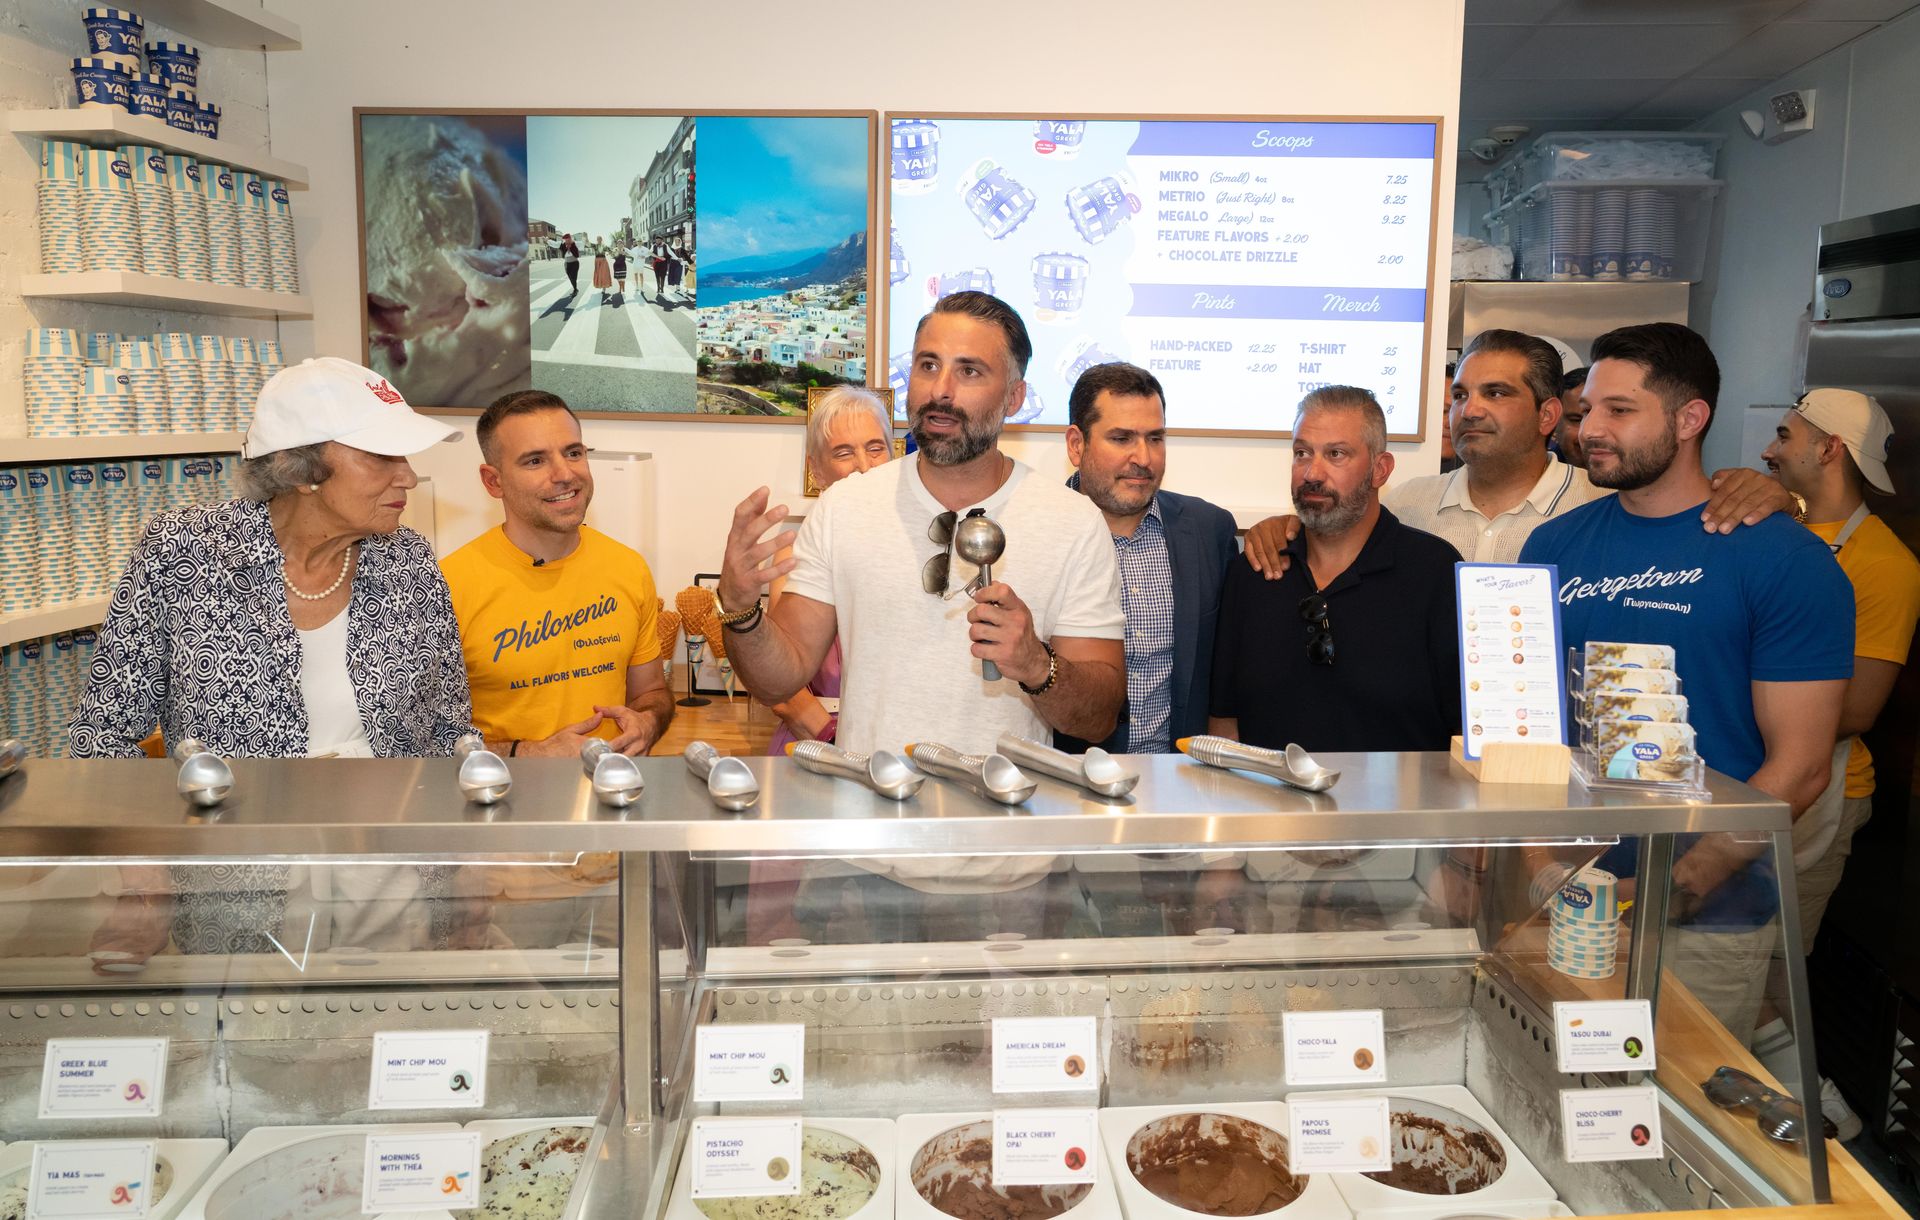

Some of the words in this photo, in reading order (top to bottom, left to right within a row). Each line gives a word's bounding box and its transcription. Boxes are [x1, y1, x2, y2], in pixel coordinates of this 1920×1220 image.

[131, 93, 166, 109] YALA
[141, 105, 162, 113] GREEK
[193, 120, 216, 133] ALA
[1048, 121, 1084, 135] YALA
[1252, 130, 1315, 152] Scoops
[901, 154, 937, 170] YALA
[1159, 171, 1199, 182] MIKRO
[1209, 171, 1250, 185] (Small)
[1385, 175, 1408, 185] 7.25
[1159, 191, 1205, 202] METRIO
[1215, 191, 1242, 205] (Just
[1244, 192, 1277, 206] Right)
[1281, 195, 1295, 203] 8oz
[1383, 195, 1408, 205] 8.25
[1158, 211, 1209, 222] MEGALO
[1218, 211, 1254, 226] Large)
[1259, 215, 1275, 223] 12oz
[1381, 215, 1406, 225] 9.25
[1157, 230, 1210, 242] FEATURE
[1214, 231, 1269, 243] FLAVORS
[1169, 250, 1242, 262] CHOCOLATE
[1246, 251, 1298, 263] DRIZZLE
[1377, 254, 1403, 265] 2.00
[1191, 291, 1237, 311] Pints
[1322, 293, 1382, 313] Merch
[1150, 339, 1233, 353] HAND-PACKED
[1248, 343, 1277, 354] 12.25
[1299, 343, 1347, 355] T-SHIRT
[1382, 346, 1398, 357] 25
[1150, 359, 1201, 371] FEATURE
[1298, 362, 1322, 374] HAT
[1380, 365, 1397, 376] 30
[1558, 565, 1704, 605] Georgetown
[493, 594, 618, 663] Philoxenia
[573, 633, 621, 650] (Φιλοξενία)
[510, 681, 529, 690] ALL
[532, 671, 570, 687] FLAVORS
[573, 662, 616, 678] WELCOME.
[1634, 747, 1660, 756] YALA
[1563, 890, 1590, 904] YALA
[1006, 1042, 1040, 1050] AMERICAN
[60, 1060, 85, 1068] GREEK
[88, 1060, 108, 1068] BLUE
[387, 1059, 406, 1067] MINT
[428, 1058, 447, 1066] MOU
[59, 1070, 95, 1078] SUMMER
[1302, 1128, 1332, 1136] PROMISE
[706, 1140, 743, 1148] PISTACHIO
[380, 1153, 421, 1162] MORNINGS
[380, 1163, 400, 1172] WITH
[403, 1163, 423, 1171] THEA
[62, 1171, 80, 1179] MAS
